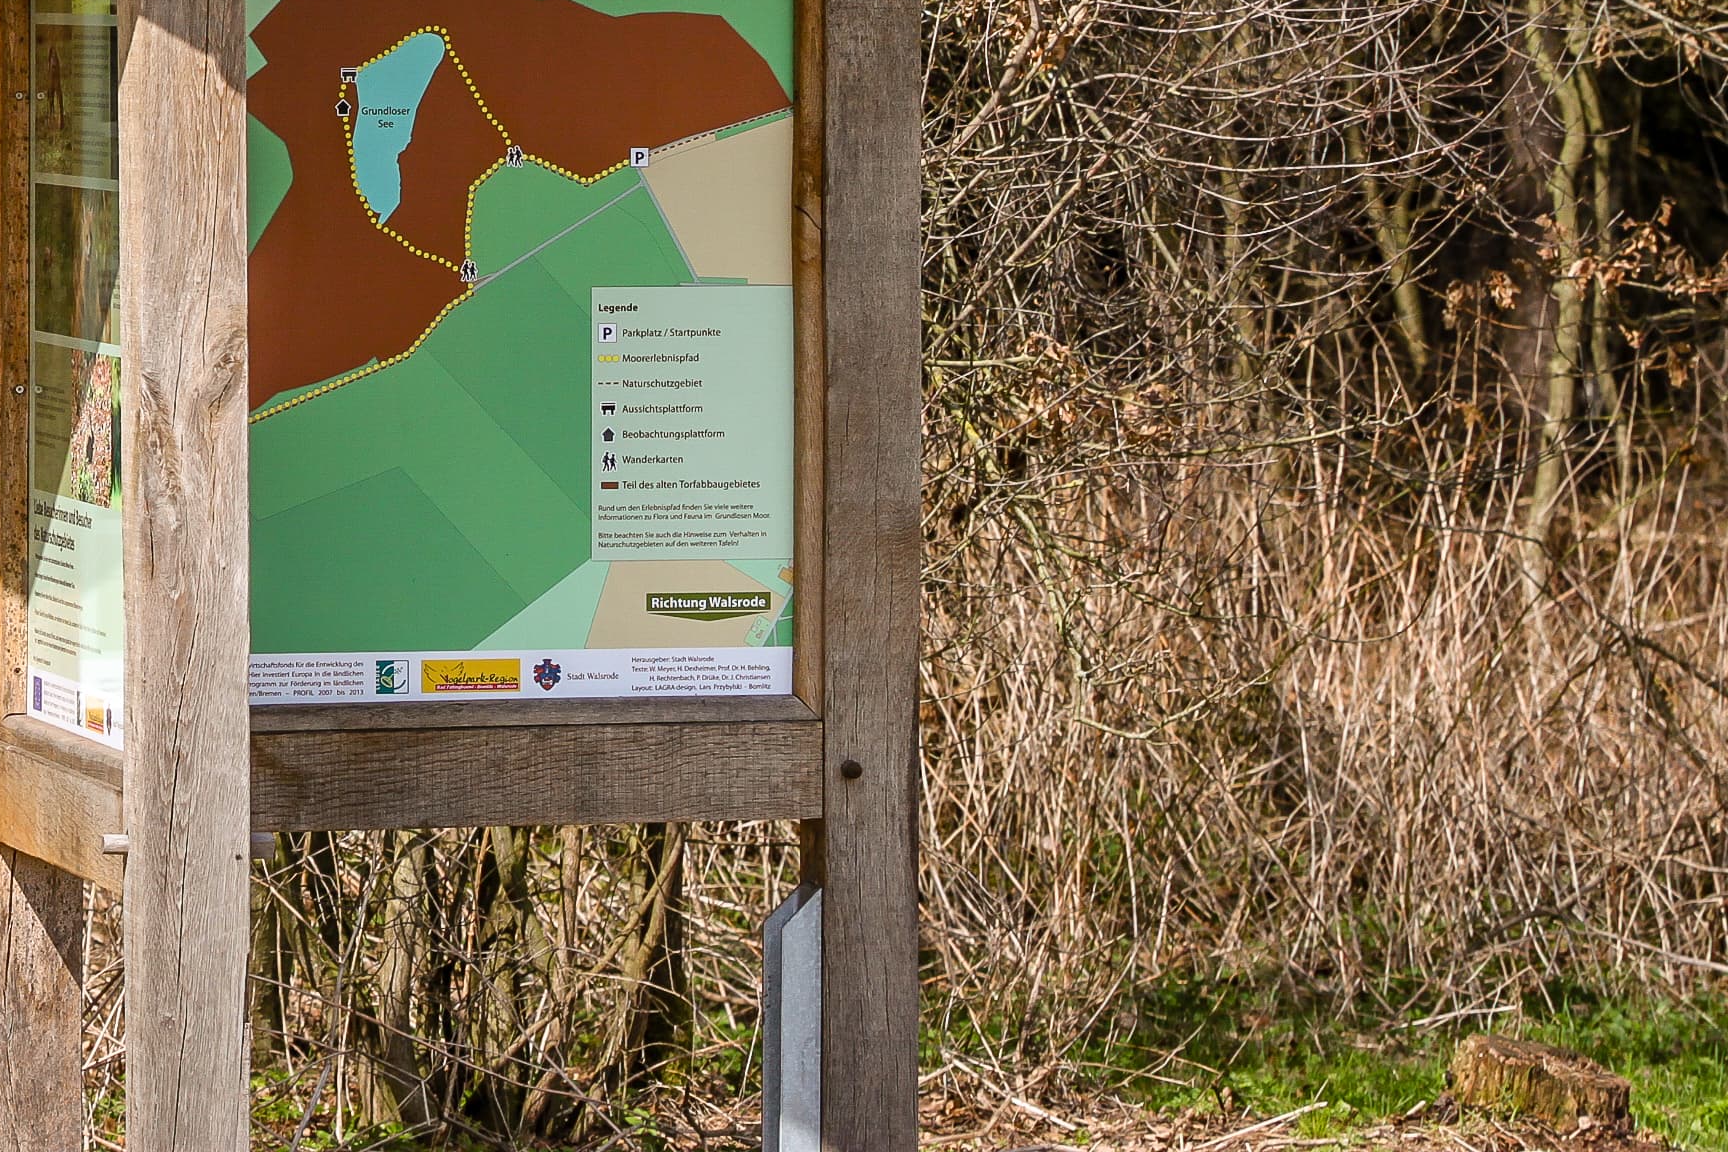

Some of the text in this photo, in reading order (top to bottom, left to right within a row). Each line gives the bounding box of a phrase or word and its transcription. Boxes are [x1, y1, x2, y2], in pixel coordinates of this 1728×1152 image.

[361, 106, 410, 115] Grundloser
[377, 120, 394, 128] See
[636, 152, 644, 164] P
[598, 303, 639, 314] Legende
[603, 328, 612, 340] P
[622, 328, 662, 339] Parkplatz
[669, 328, 721, 339] Startpunkte
[622, 353, 700, 364] Moorerlebnispfad
[622, 379, 703, 390] Naturschutzgebiet
[622, 404, 703, 415] Aussichtsplattform
[622, 429, 725, 441] Beobachtungsplattform
[622, 455, 684, 464] Wanderkarten
[622, 480, 760, 491] Teil des alten Torfabbaugebietes
[641, 504, 681, 512] Erlebnispfad
[714, 512, 752, 520] Grundlosen
[598, 540, 664, 549] Naturschutzgebieten
[651, 597, 766, 611] Richtung Walsrode
[440, 673, 517, 684] Vogelpark-Region
[587, 672, 619, 680] Walsrode
